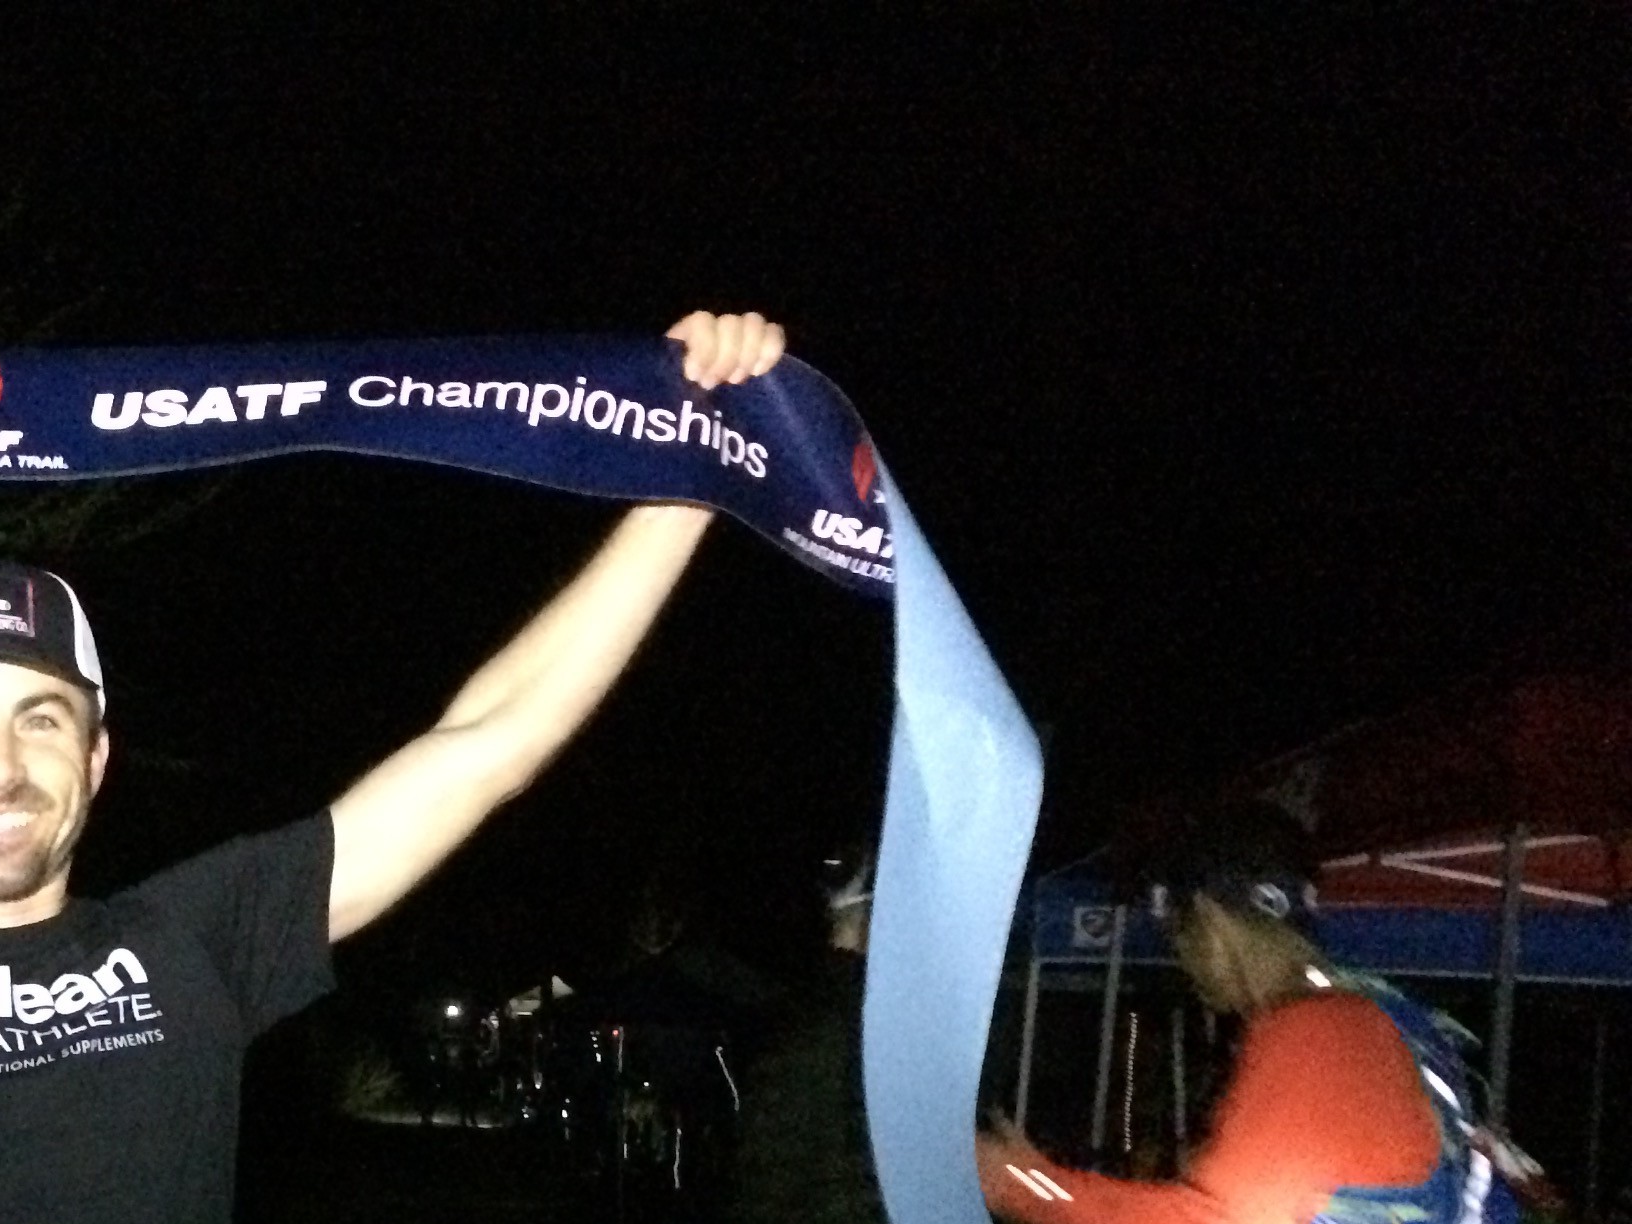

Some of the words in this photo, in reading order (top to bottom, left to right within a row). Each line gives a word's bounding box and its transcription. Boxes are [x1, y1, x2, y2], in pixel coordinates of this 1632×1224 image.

[90, 380, 328, 430] USATF
[348, 375, 769, 479] Championships
[16, 454, 68, 470] TRAIL
[61, 1028, 165, 1058] SUPPLEMENTS
